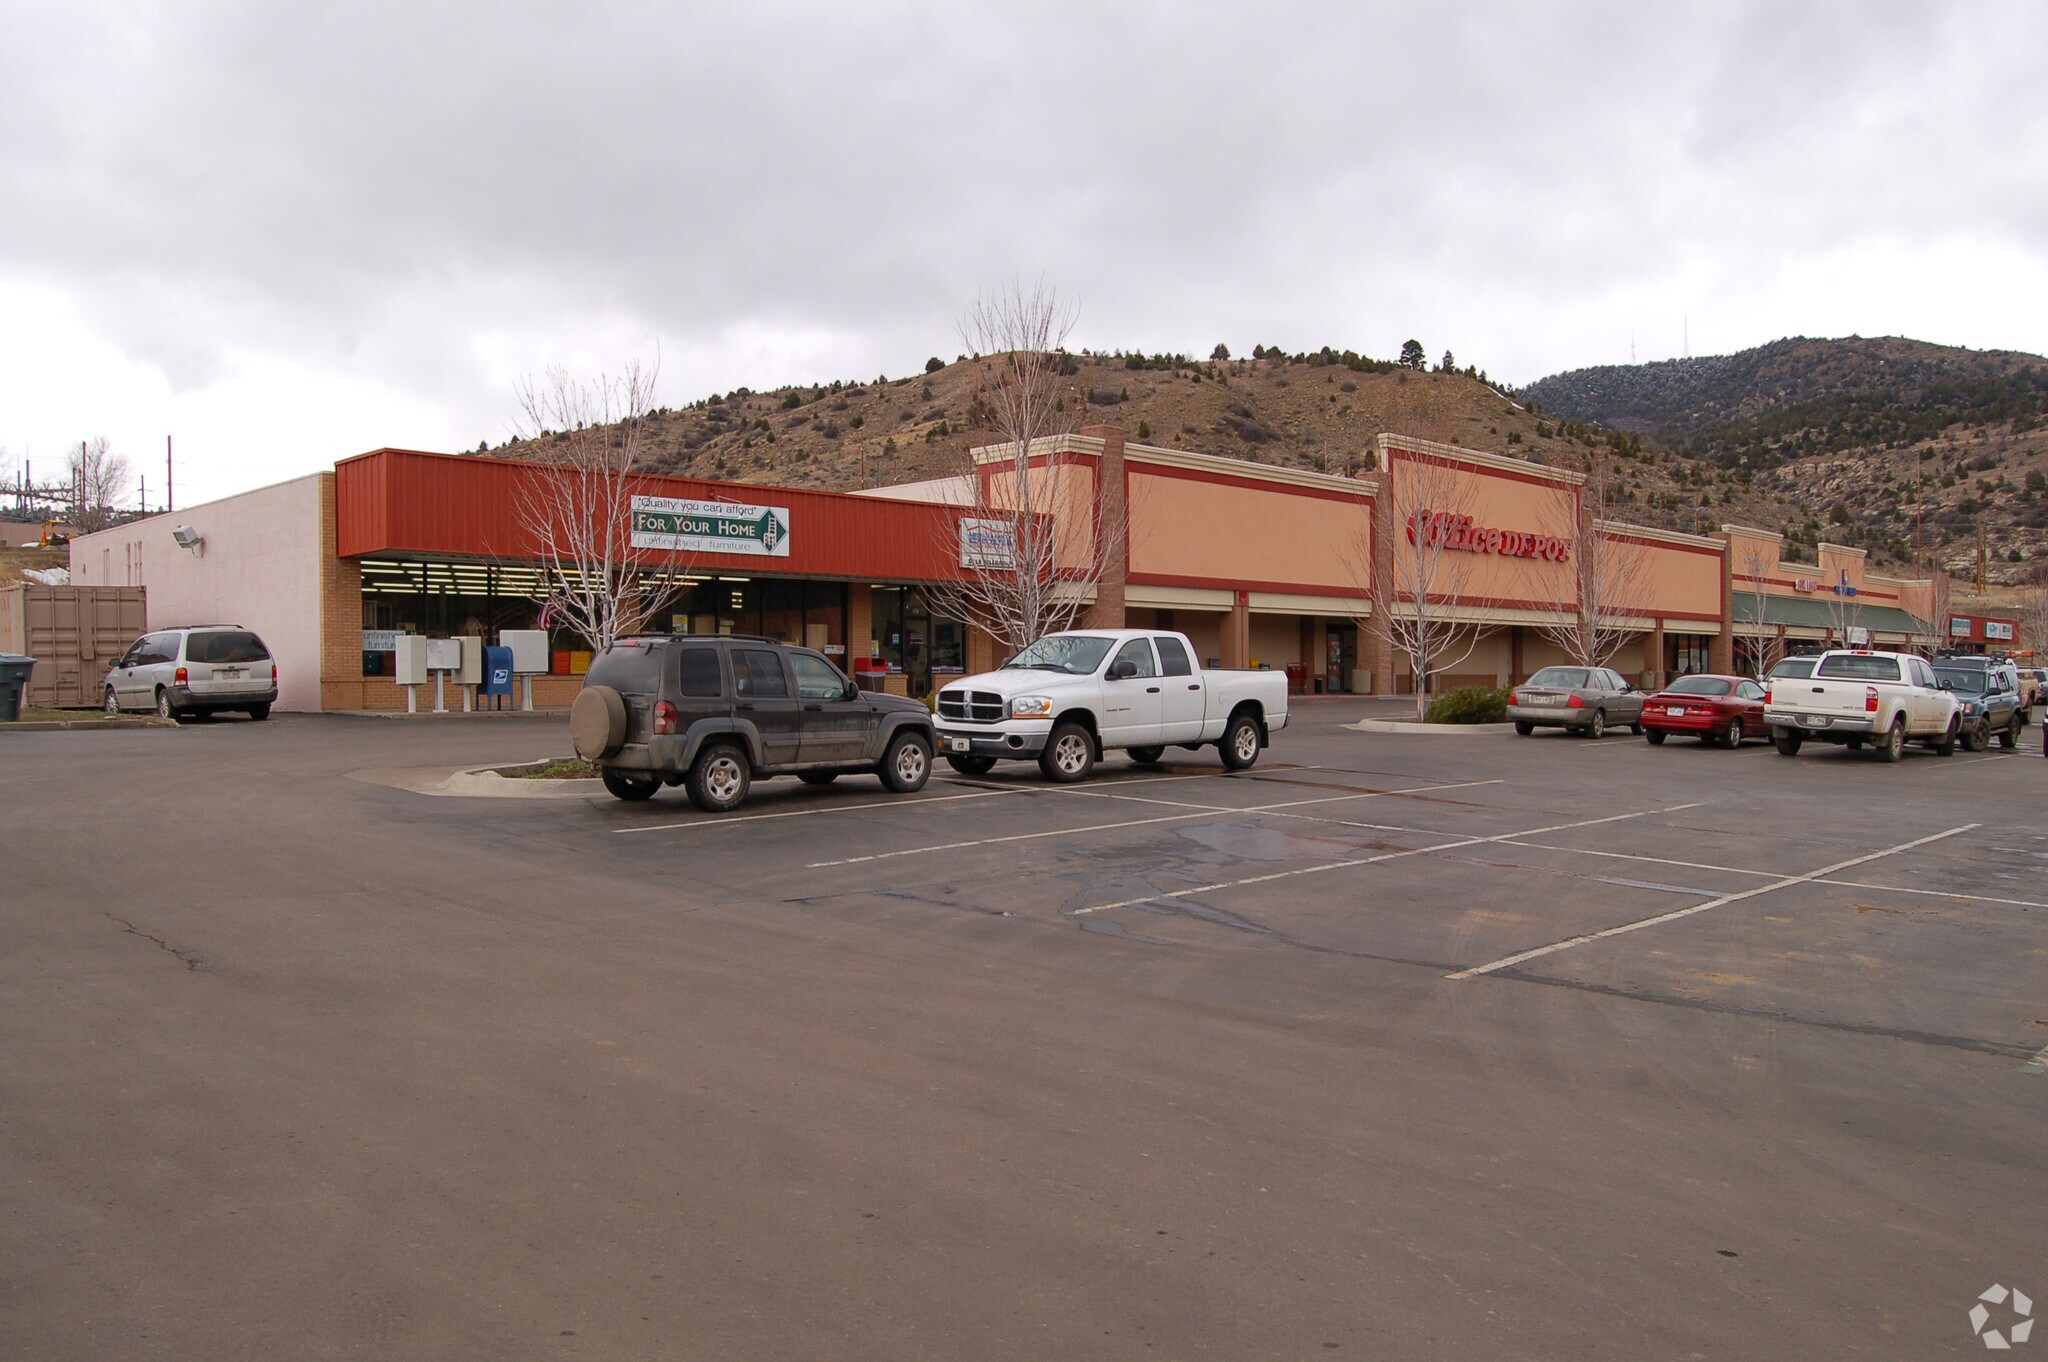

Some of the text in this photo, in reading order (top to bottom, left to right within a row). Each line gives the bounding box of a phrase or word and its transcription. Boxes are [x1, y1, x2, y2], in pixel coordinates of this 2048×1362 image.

[681, 502, 699, 511] you
[703, 504, 722, 512] can
[643, 537, 751, 551] unfinished furniture
[1499, 530, 1574, 562] DEPOT
